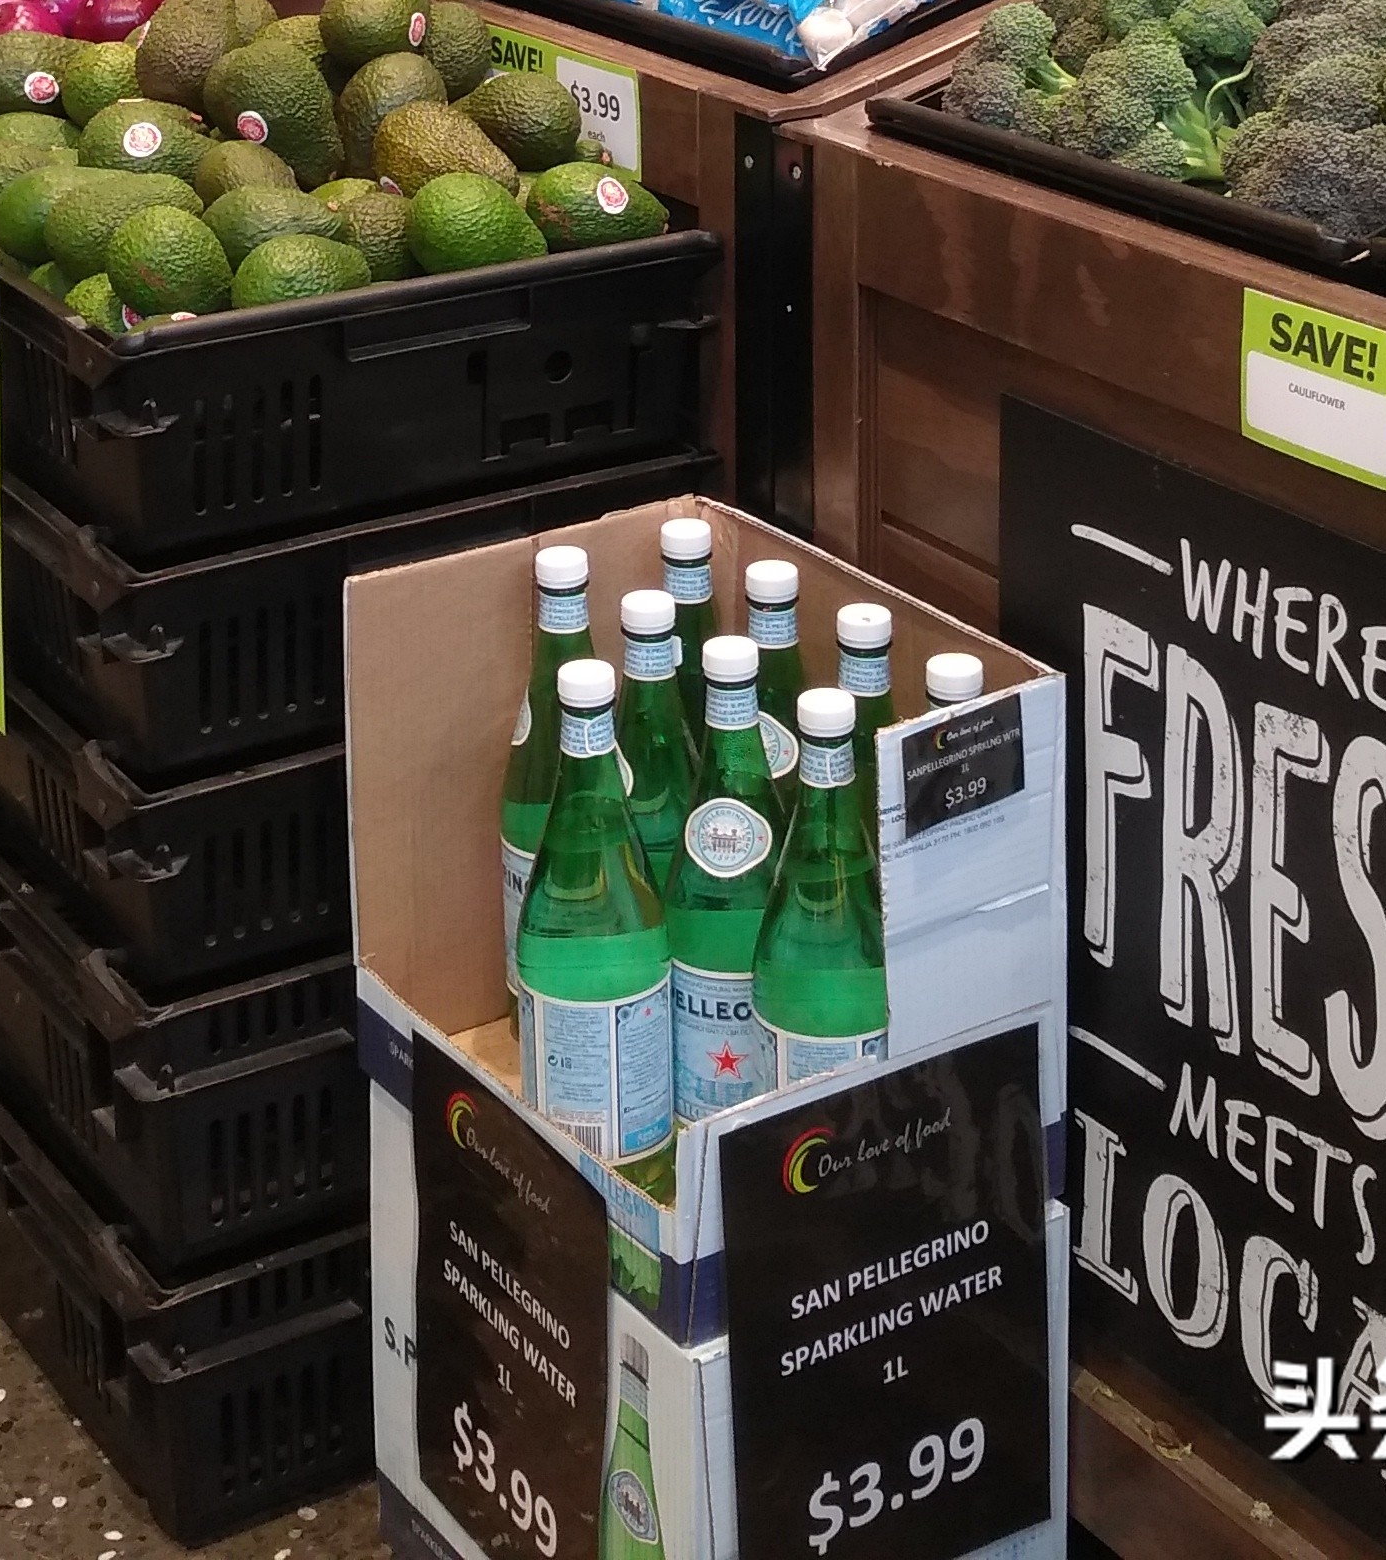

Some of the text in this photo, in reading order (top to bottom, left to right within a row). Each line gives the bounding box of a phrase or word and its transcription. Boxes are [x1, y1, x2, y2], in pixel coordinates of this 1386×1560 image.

[491, 35, 543, 74] SAVE!
[1269, 311, 1378, 383] SAVE!
[1288, 381, 1346, 411] CAULIFLOWER
[945, 776, 987, 810] $3.99
[914, 1106, 952, 1146] food
[1169, 1062, 1378, 1266] MEETS
[448, 1219, 571, 1350] SAN PELLEGRINO
[790, 1218, 990, 1320] SAN PELLEGRINO
[442, 1258, 578, 1408] SPARKLING WATER
[779, 1264, 1004, 1378] SPARKLING WATER
[497, 1362, 515, 1396] 1L
[881, 1354, 909, 1386] 1L
[452, 1400, 558, 1559] $3.99
[807, 1416, 986, 1556] $3.99
